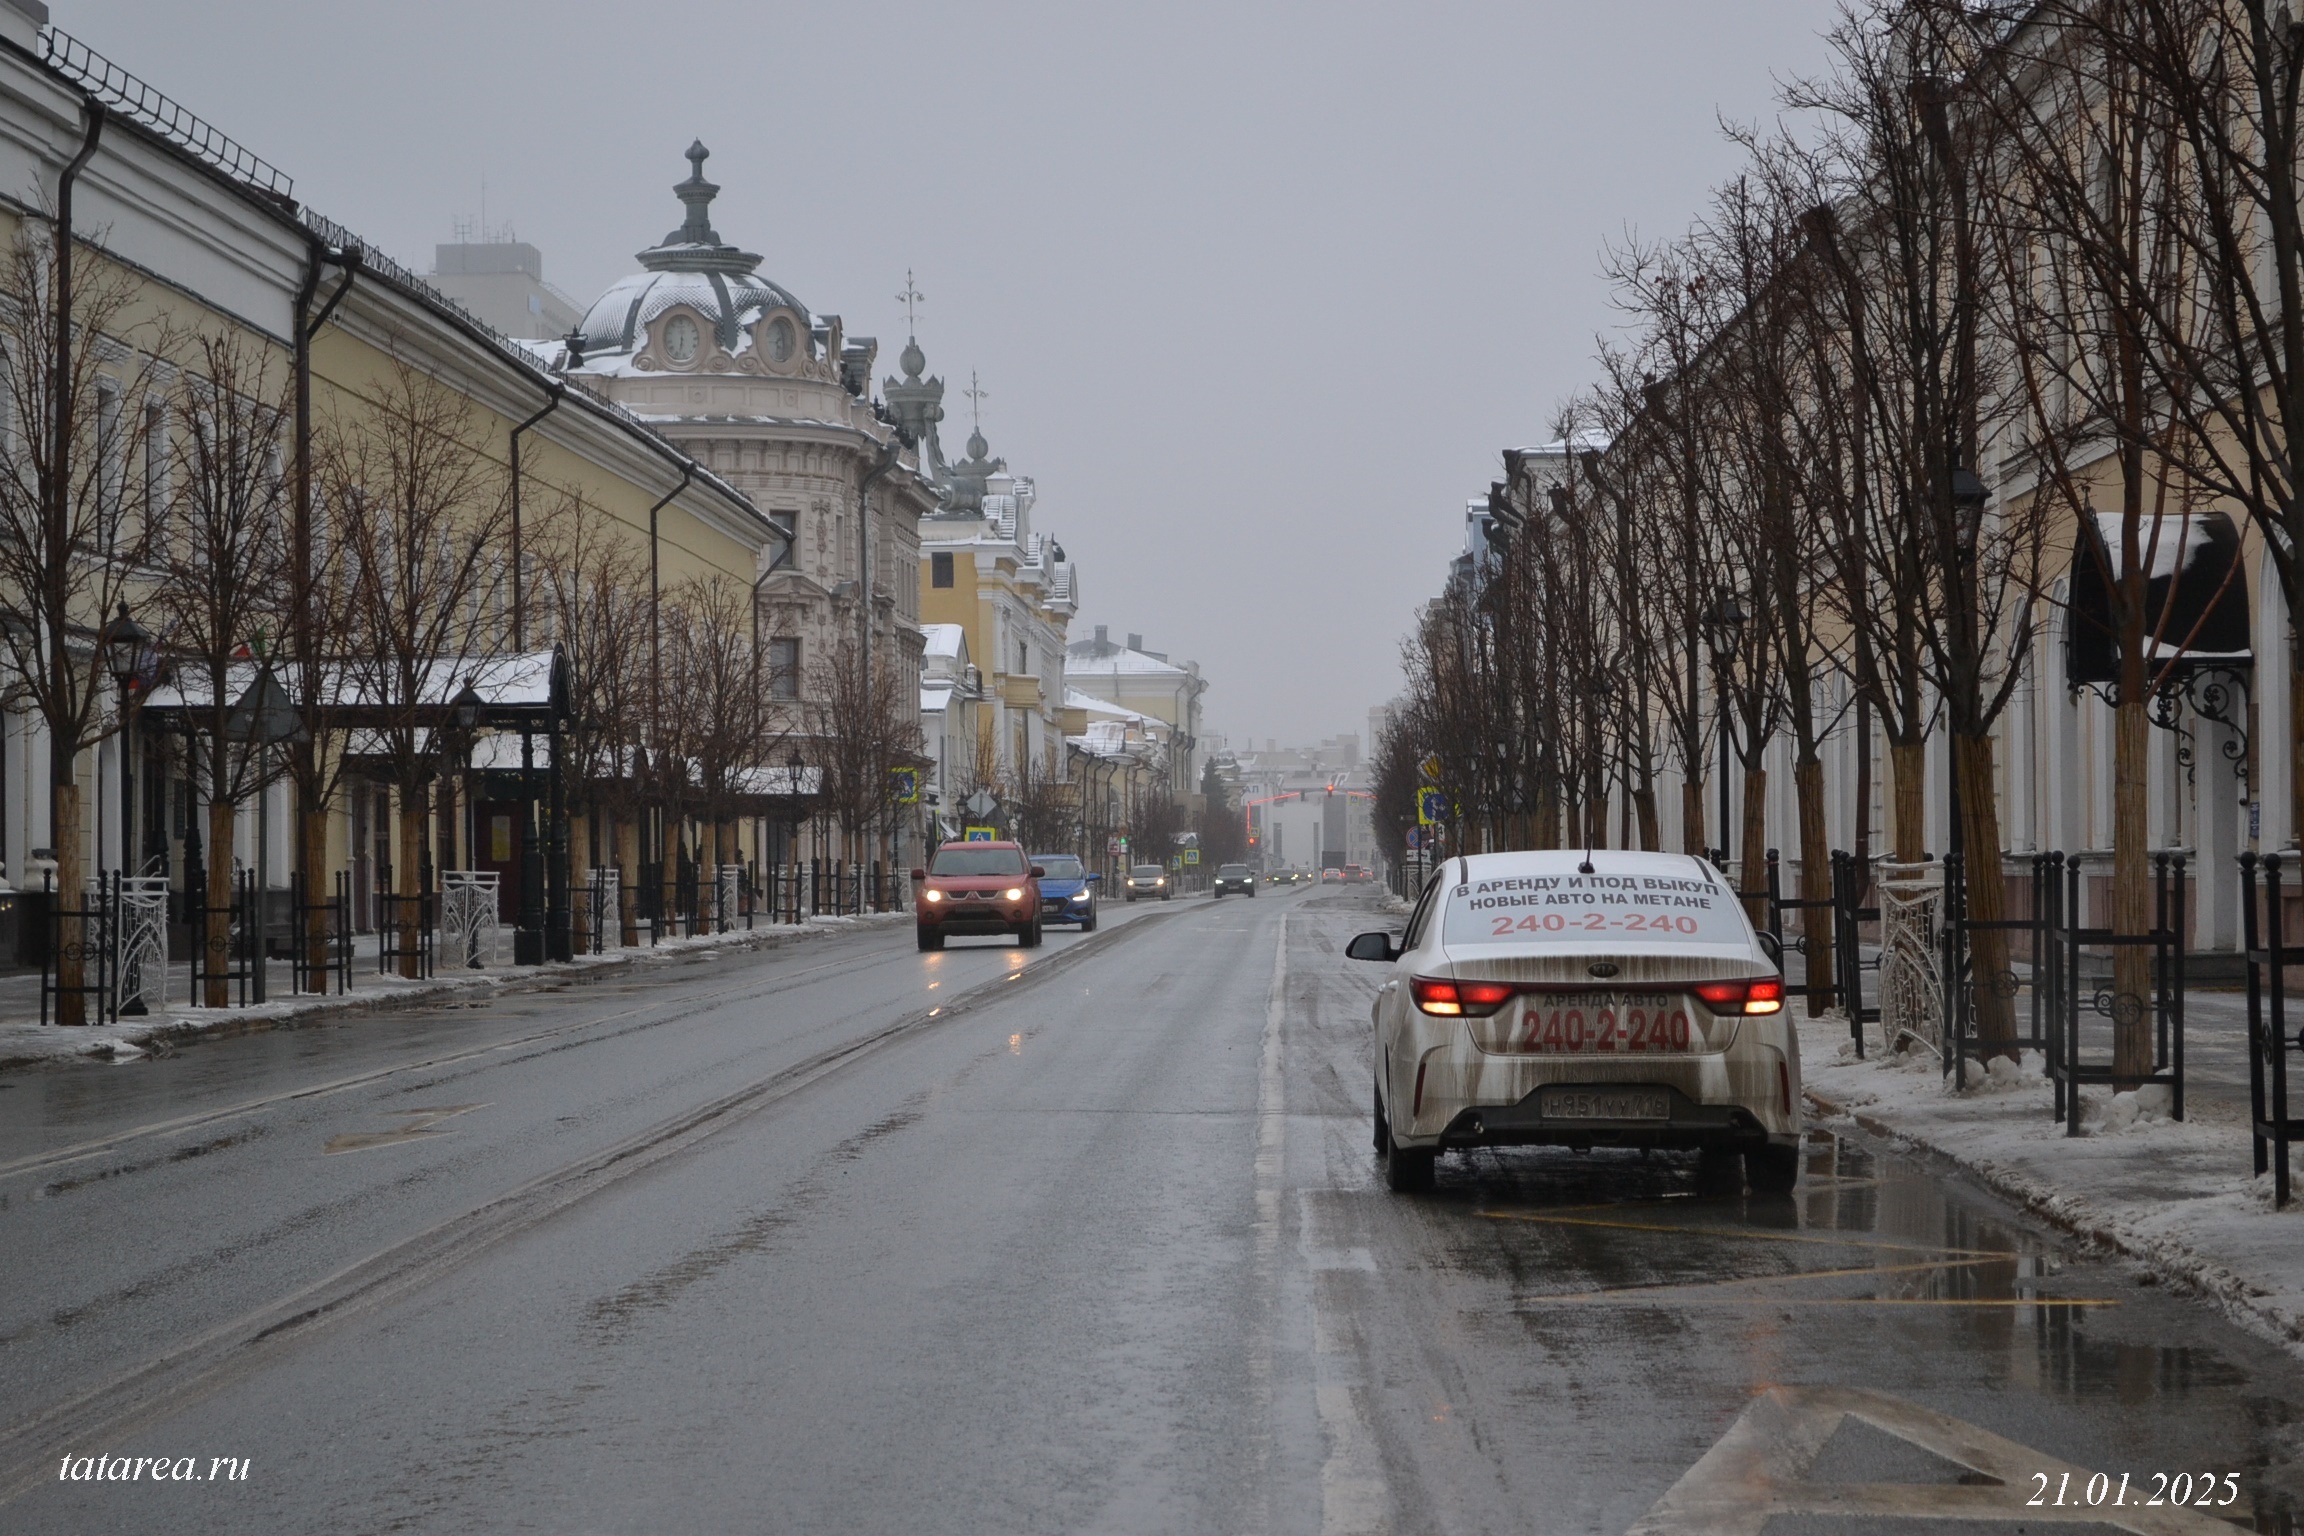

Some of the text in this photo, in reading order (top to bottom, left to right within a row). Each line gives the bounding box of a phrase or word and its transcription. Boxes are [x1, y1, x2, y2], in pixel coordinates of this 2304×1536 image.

[1457, 877, 1719, 898] В АРЕНДУ И ПОД ВЫКУП
[1469, 893, 1711, 911] НОВЫЕ АВТО НА МЕТАНЕ
[1491, 913, 1698, 936] 240-2-240
[1543, 993, 1668, 1009] АРЕНДА АВТО
[1522, 1009, 1690, 1051] 240-2-240
